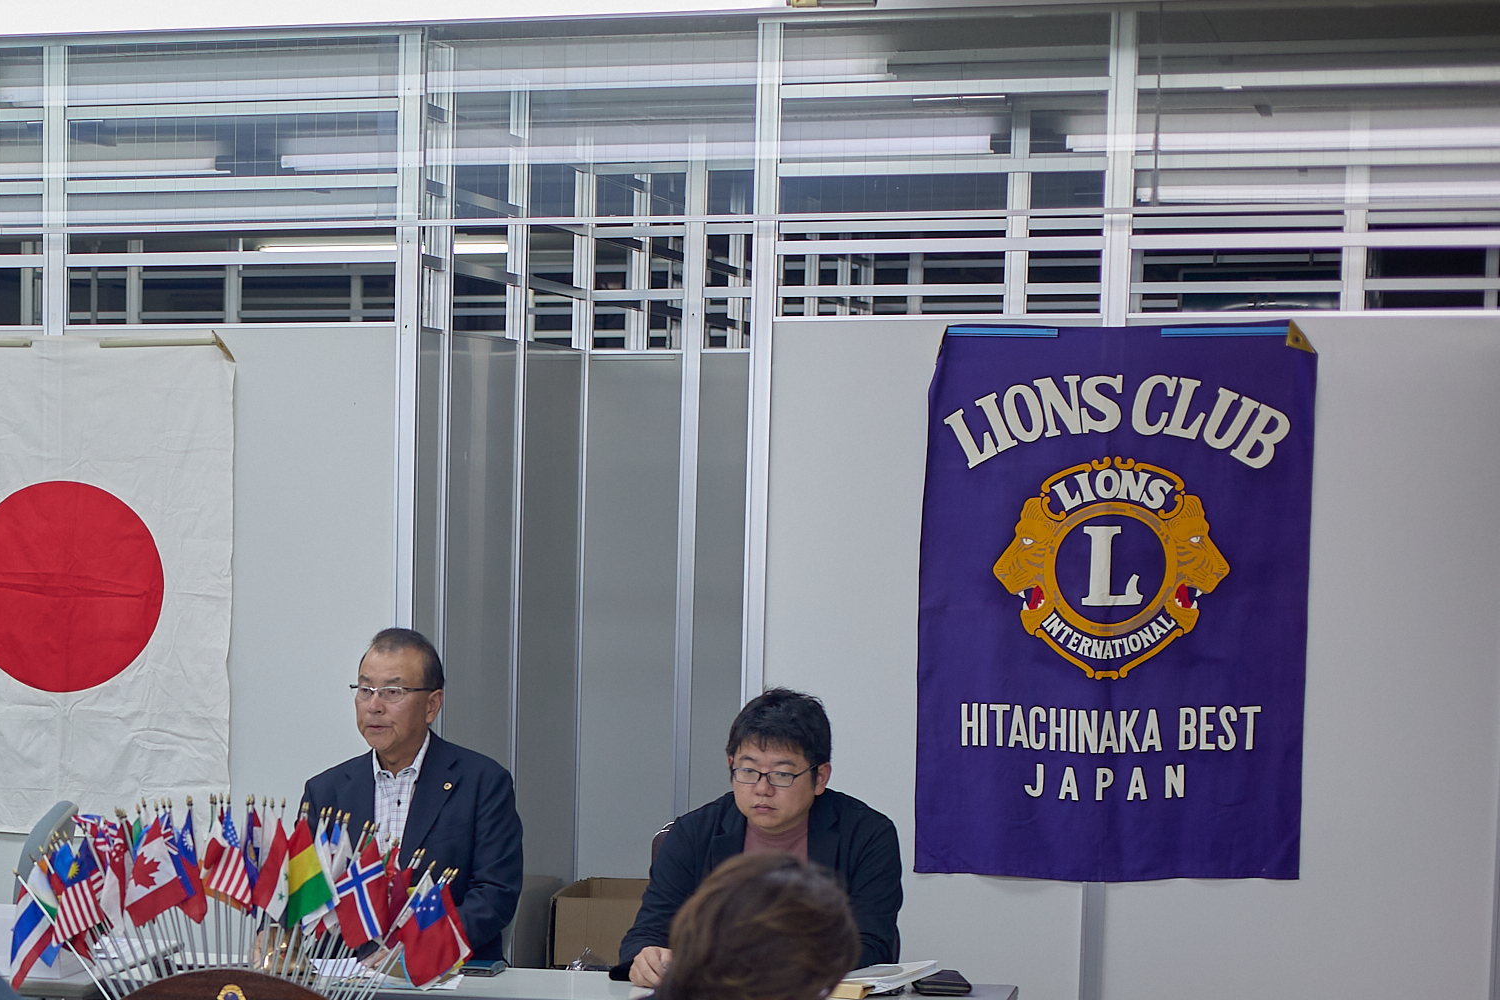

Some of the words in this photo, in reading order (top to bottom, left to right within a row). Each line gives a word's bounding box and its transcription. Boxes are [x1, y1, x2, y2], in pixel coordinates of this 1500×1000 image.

[943, 374, 1123, 469] LIONS
[1130, 374, 1291, 469] CLUB
[1051, 468, 1174, 512] LIONS
[1081, 525, 1144, 606] L
[1041, 612, 1177, 660] INTERNATIONAL
[960, 702, 1163, 754] HITACHINAKA
[1178, 706, 1263, 752] BEST
[1023, 763, 1186, 801] JAPAN
